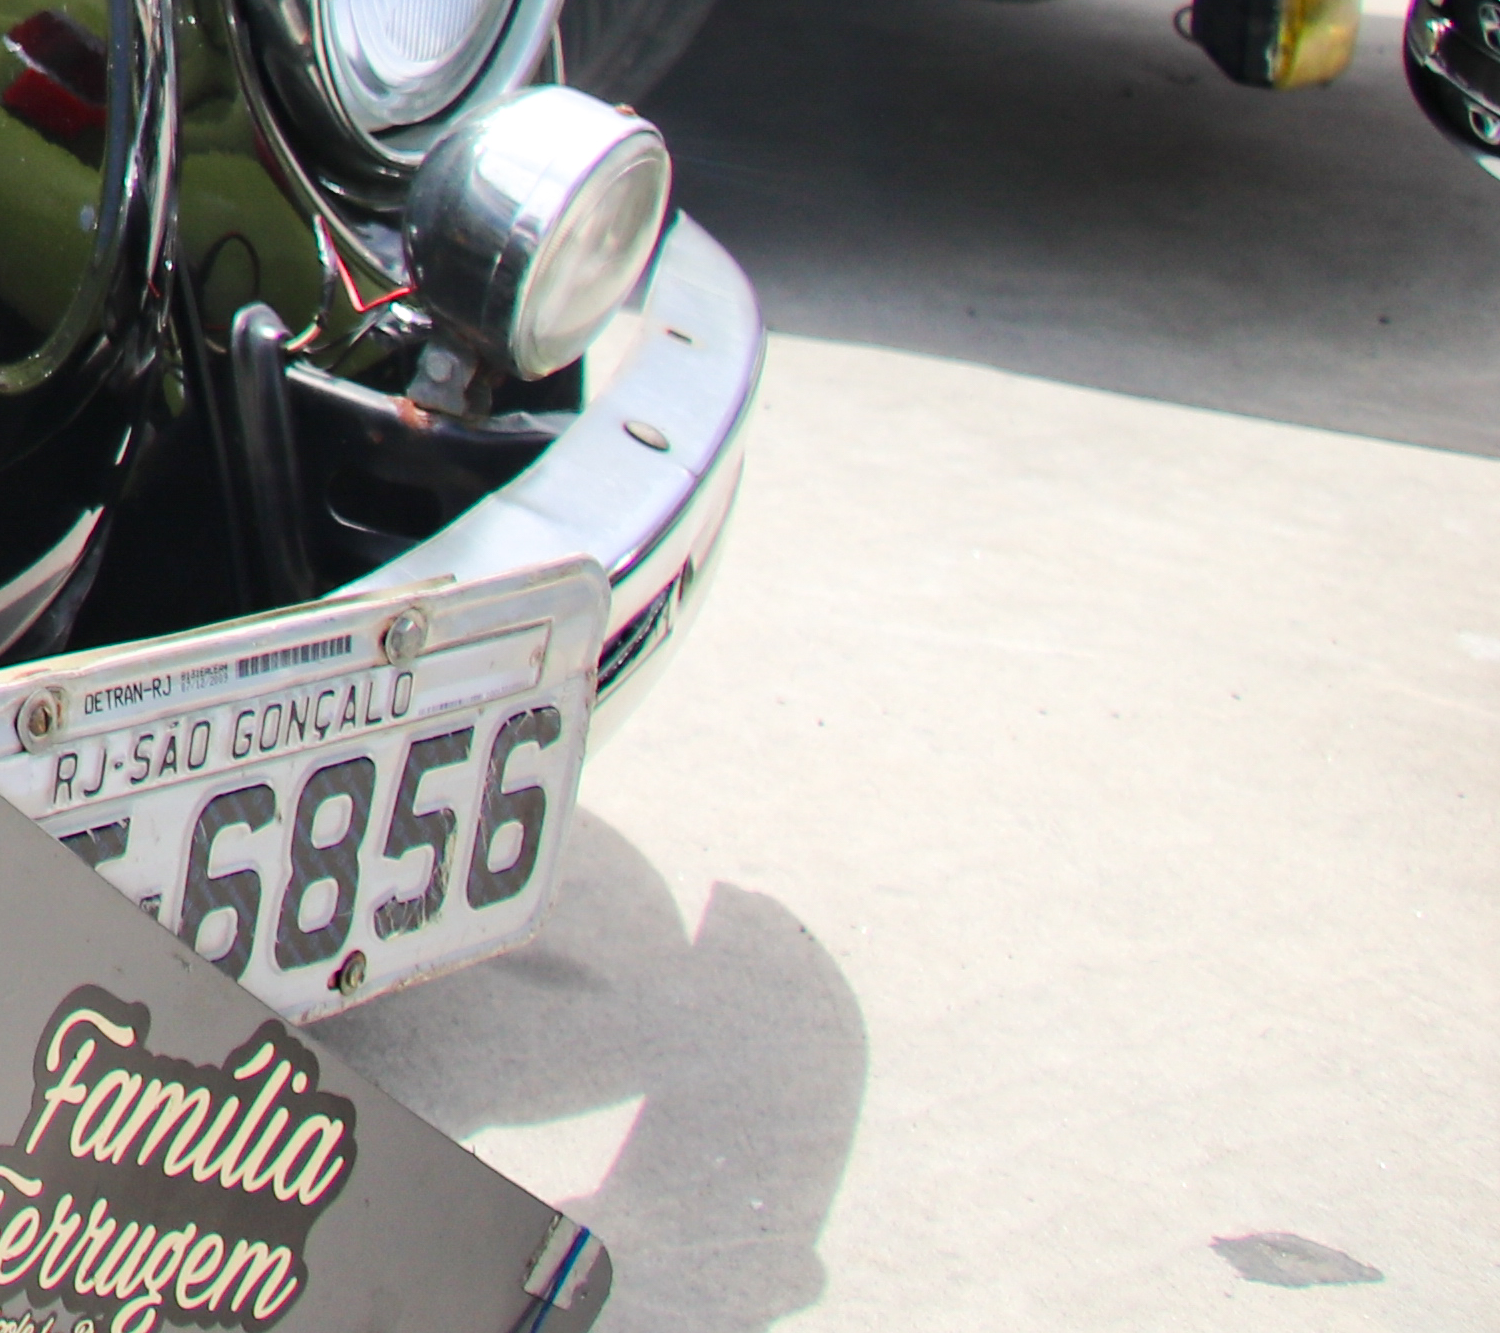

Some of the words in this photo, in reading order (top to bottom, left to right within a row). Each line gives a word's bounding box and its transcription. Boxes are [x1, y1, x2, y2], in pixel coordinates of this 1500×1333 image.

[84, 674, 172, 716] DETRAN-RJ
[231, 671, 414, 760] GONÇALO
[26, 1008, 345, 1205] Família
